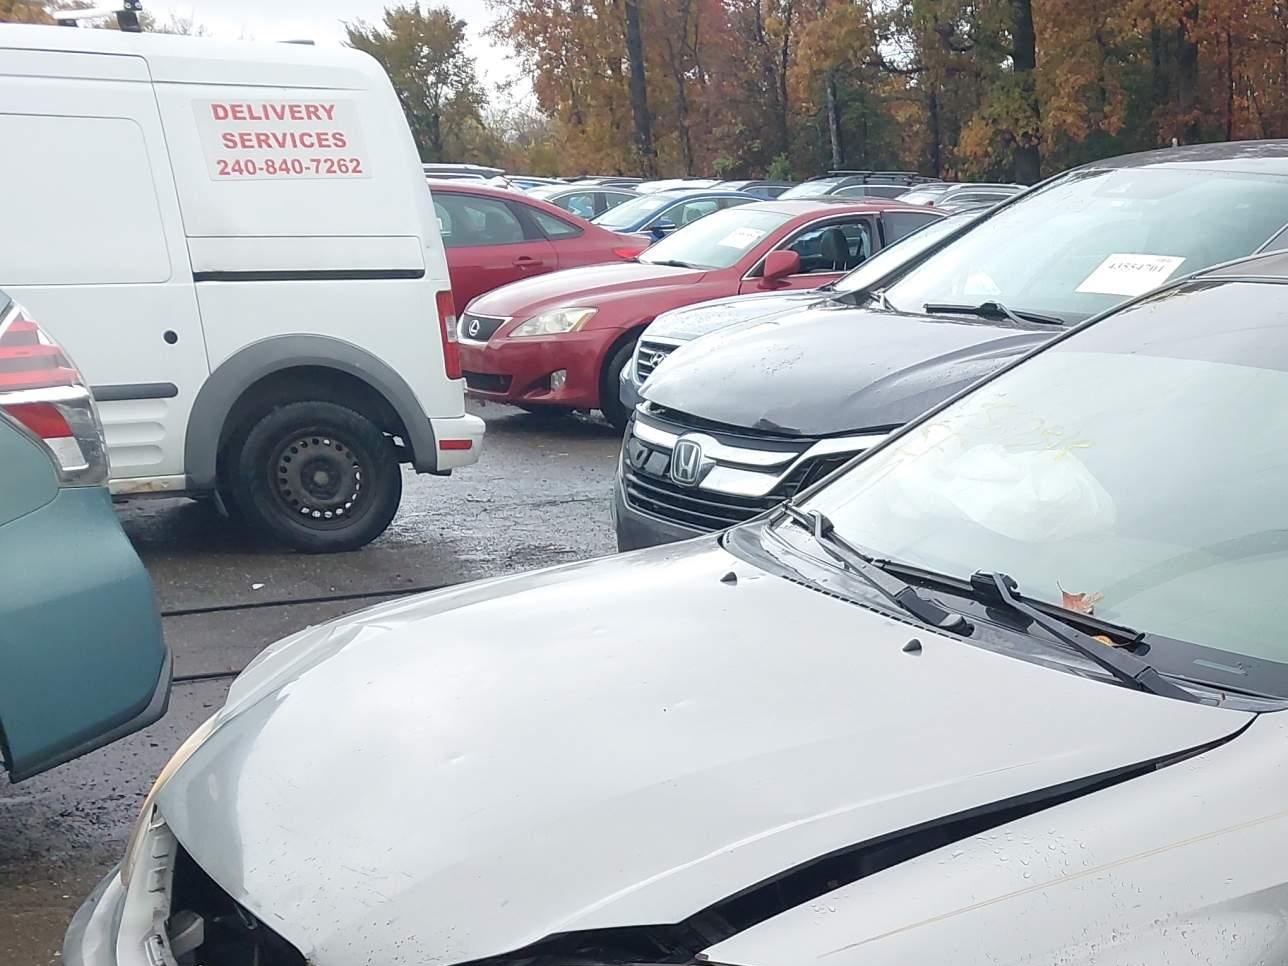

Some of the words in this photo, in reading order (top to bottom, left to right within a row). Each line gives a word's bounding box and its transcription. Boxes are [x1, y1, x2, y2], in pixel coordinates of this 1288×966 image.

[211, 104, 335, 120] DELIVERY
[222, 132, 347, 149] SERVICES
[216, 158, 363, 176] 240-840-7262
